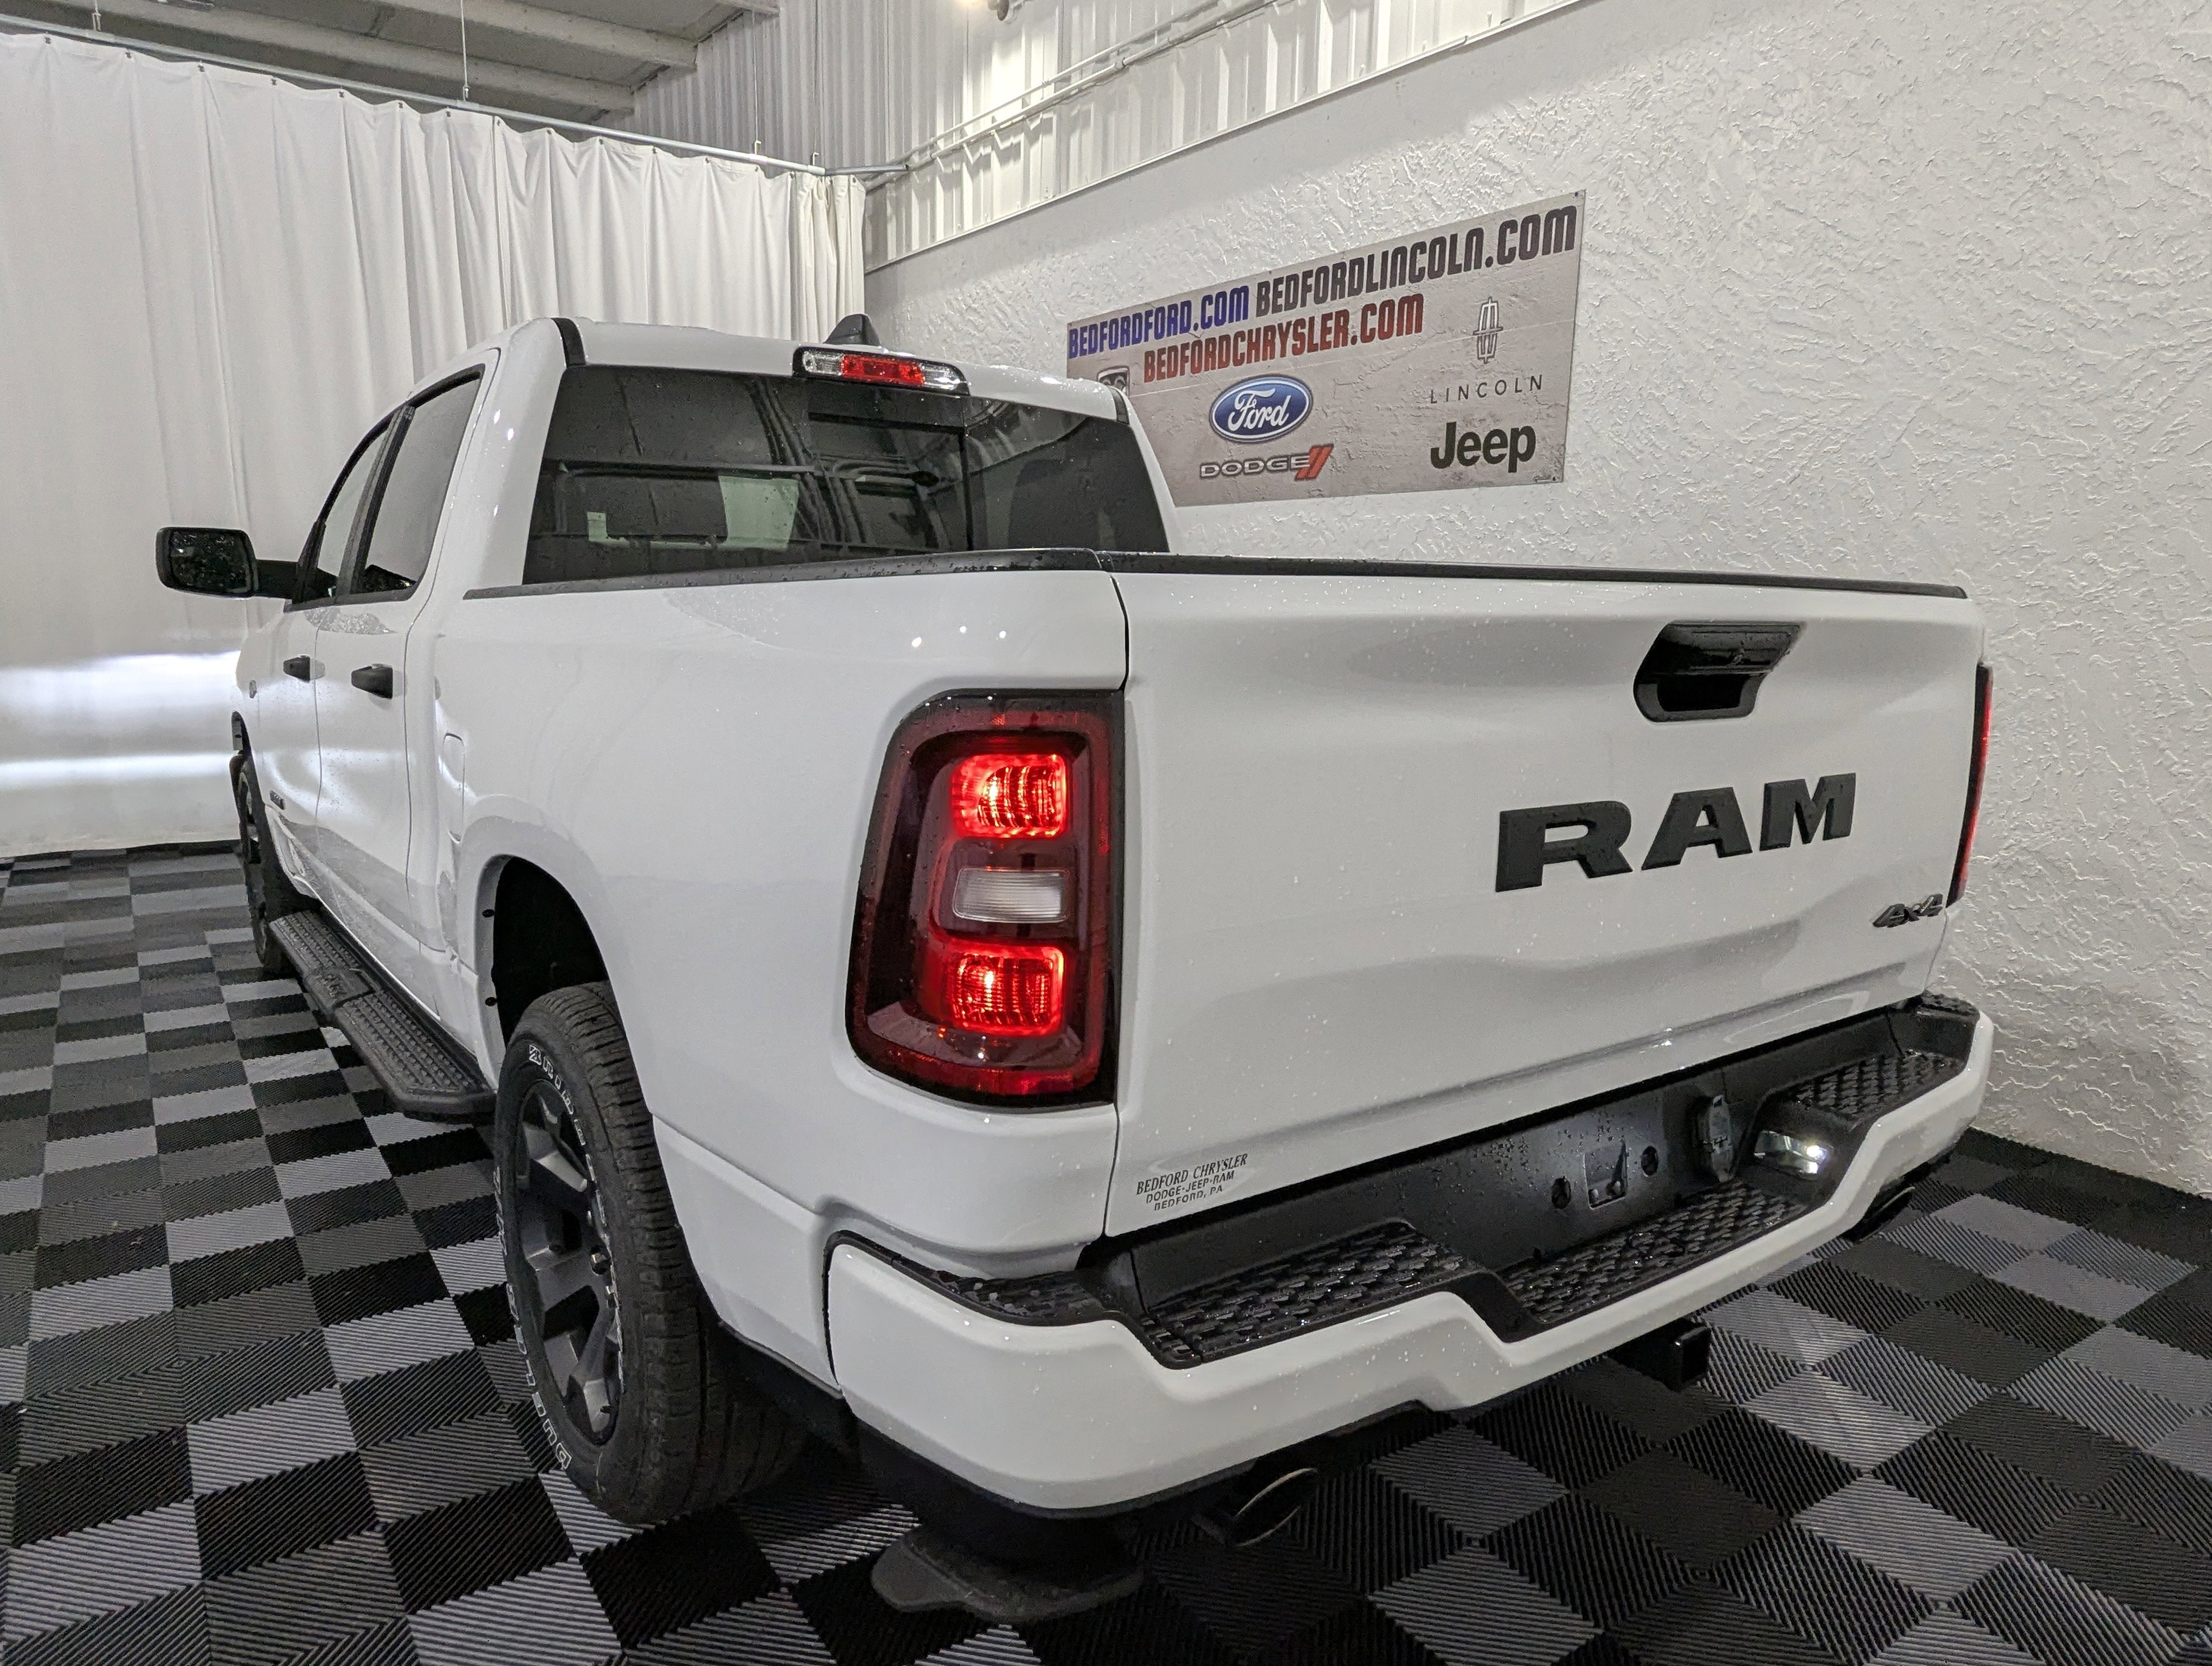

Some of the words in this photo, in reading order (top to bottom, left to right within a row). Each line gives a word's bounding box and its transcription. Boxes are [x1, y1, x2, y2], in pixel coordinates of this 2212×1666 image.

[1069, 285, 1249, 359] BEDFORDFORD.COM
[1256, 206, 1577, 317] BEDFORDLINCOLN.COM
[1144, 293, 1424, 383] BEDFORDCHRYSLER.COM
[1227, 388, 1292, 431] Ford
[1430, 374, 1542, 403] LINCOLN
[1199, 453, 1311, 479] DODGE
[1430, 421, 1536, 473] Jeep
[1495, 773, 1856, 893] RAM
[1136, 1170, 1188, 1195] BEDFORD
[1193, 1154, 1248, 1179] CHRYSLER
[1154, 1191, 1206, 1211] BEDFORD,
[1210, 1184, 1223, 1195] PA
